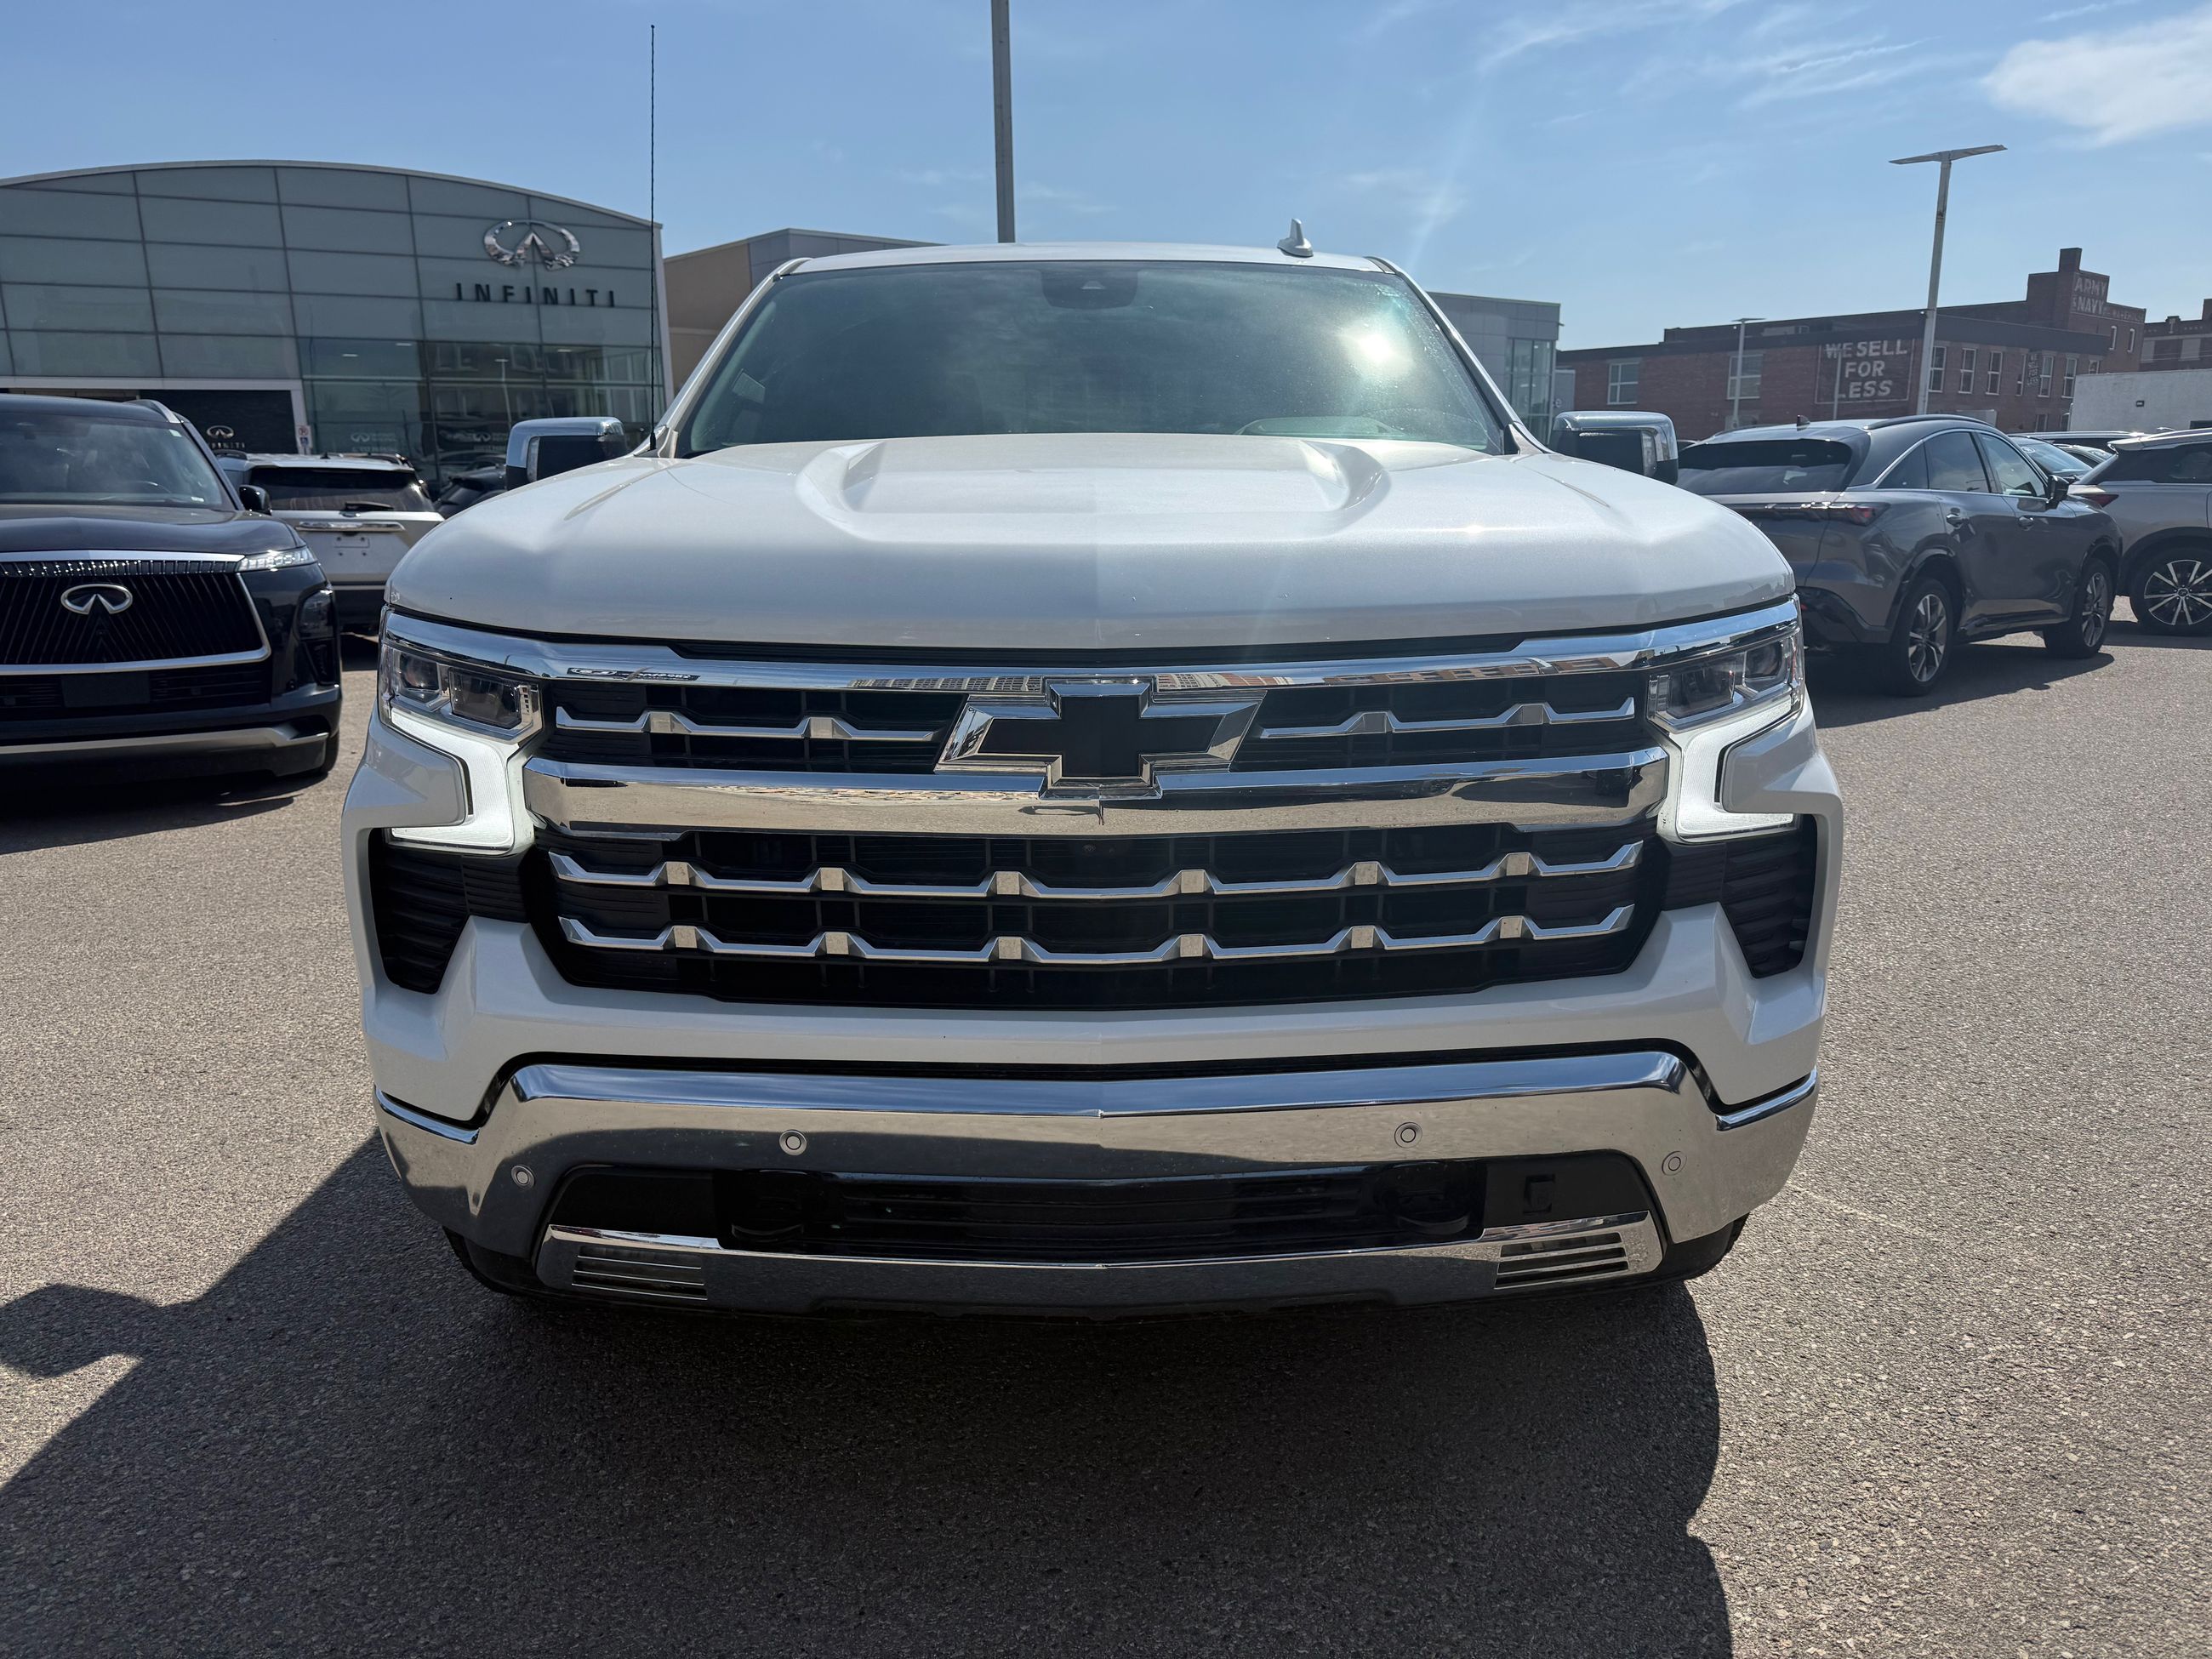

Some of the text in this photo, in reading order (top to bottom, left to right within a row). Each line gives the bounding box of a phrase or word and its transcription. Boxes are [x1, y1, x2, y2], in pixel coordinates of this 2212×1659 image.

[456, 282, 614, 308] INFINITI
[2074, 277, 2107, 296] ARMY
[2077, 295, 2104, 316] NAVY
[1825, 339, 1907, 358] WE SELL
[1844, 360, 1885, 379] FOR
